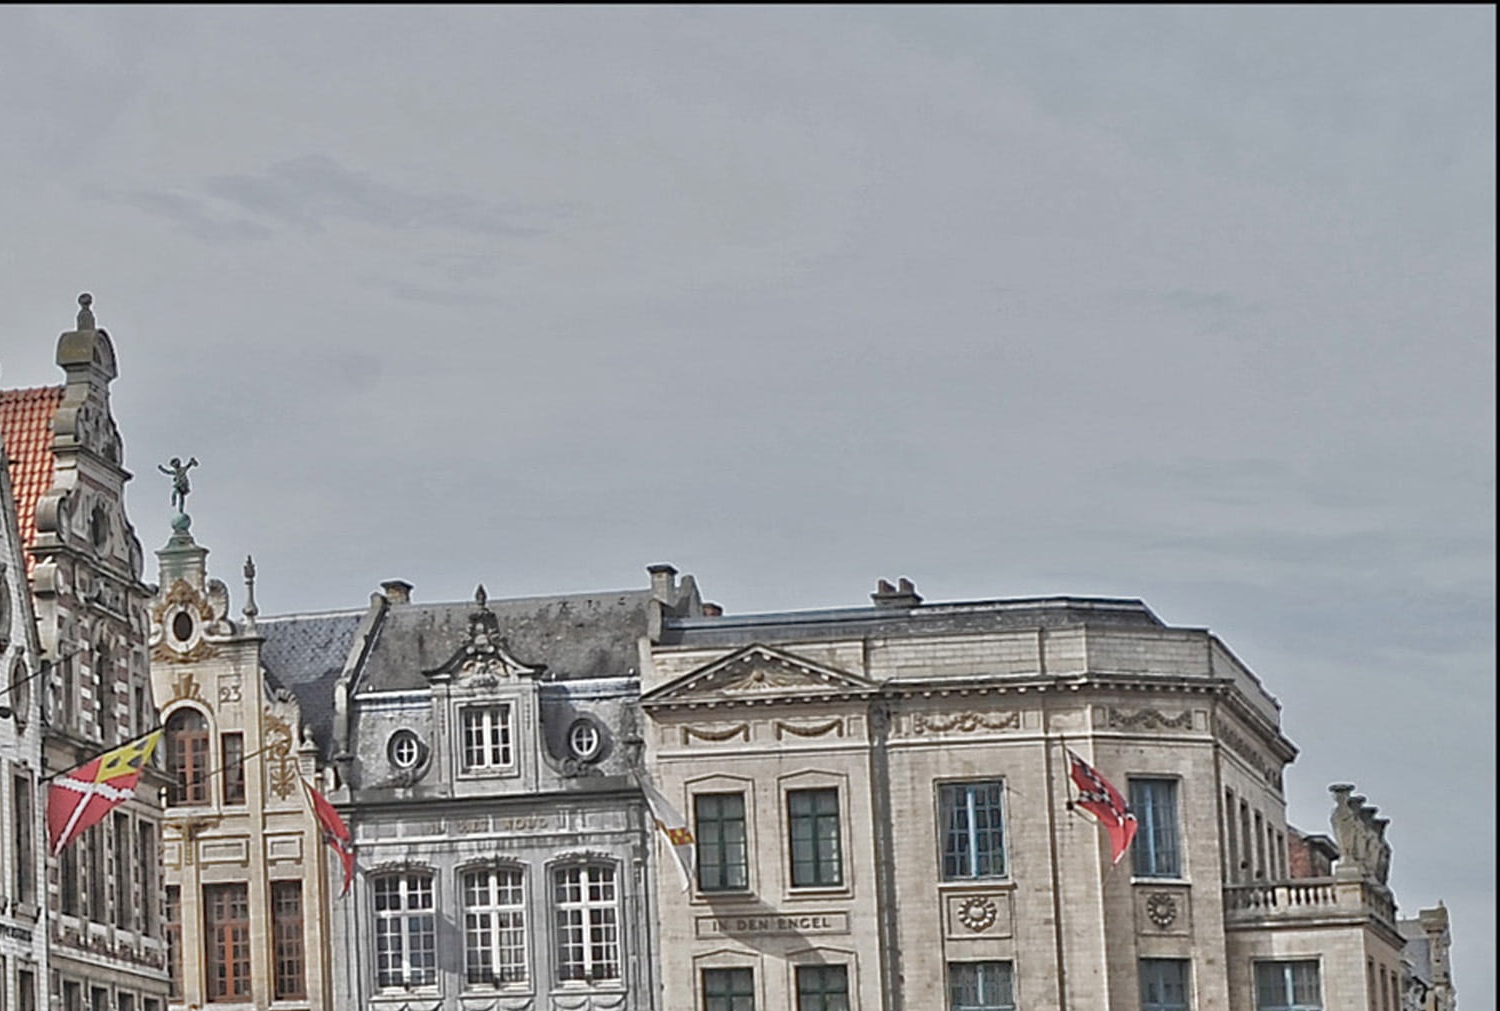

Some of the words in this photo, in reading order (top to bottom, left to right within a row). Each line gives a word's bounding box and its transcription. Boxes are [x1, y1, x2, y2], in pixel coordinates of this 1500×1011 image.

[712, 919, 729, 932] IN
[736, 918, 769, 931] DEN
[777, 916, 841, 930] ENGEL
